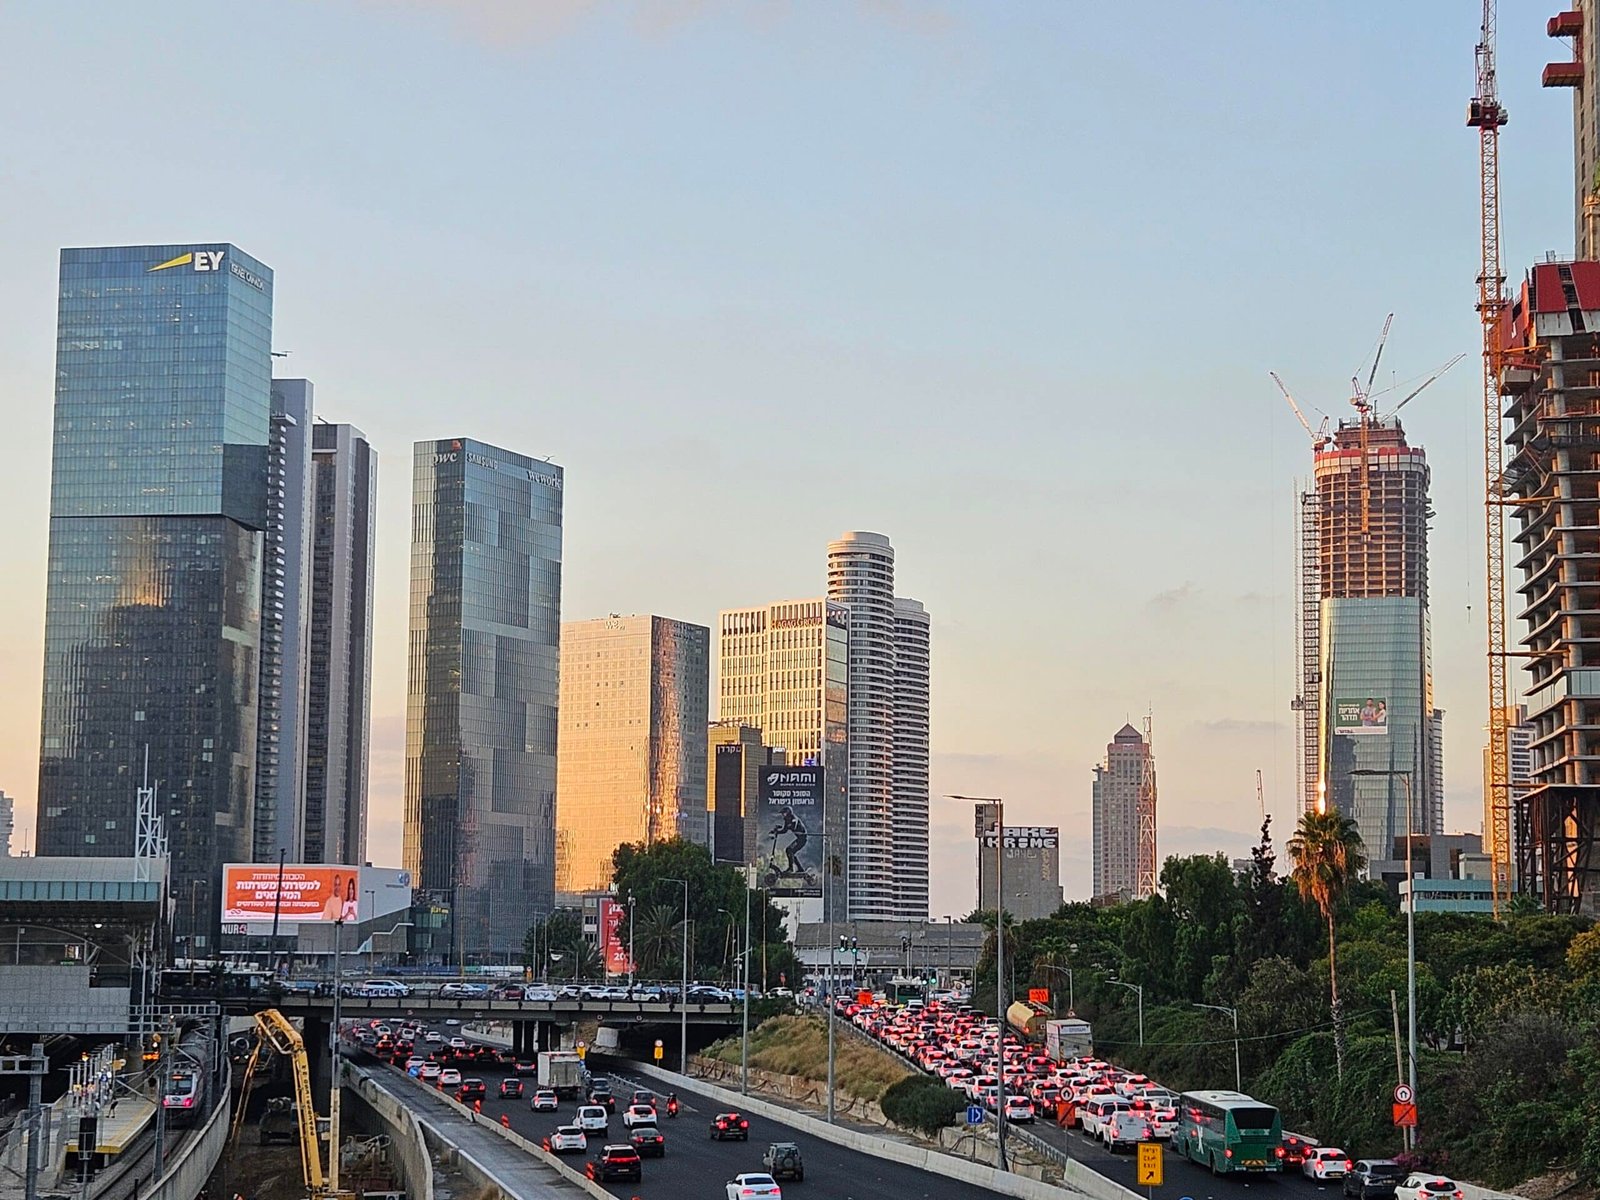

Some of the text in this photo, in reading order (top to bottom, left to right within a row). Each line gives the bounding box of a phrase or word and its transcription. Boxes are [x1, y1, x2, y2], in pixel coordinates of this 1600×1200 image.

[194, 251, 225, 271] EY
[467, 453, 498, 470] SAMSUNG
[780, 773, 816, 783] NAMI
[281, 880, 321, 890] למשרתי
